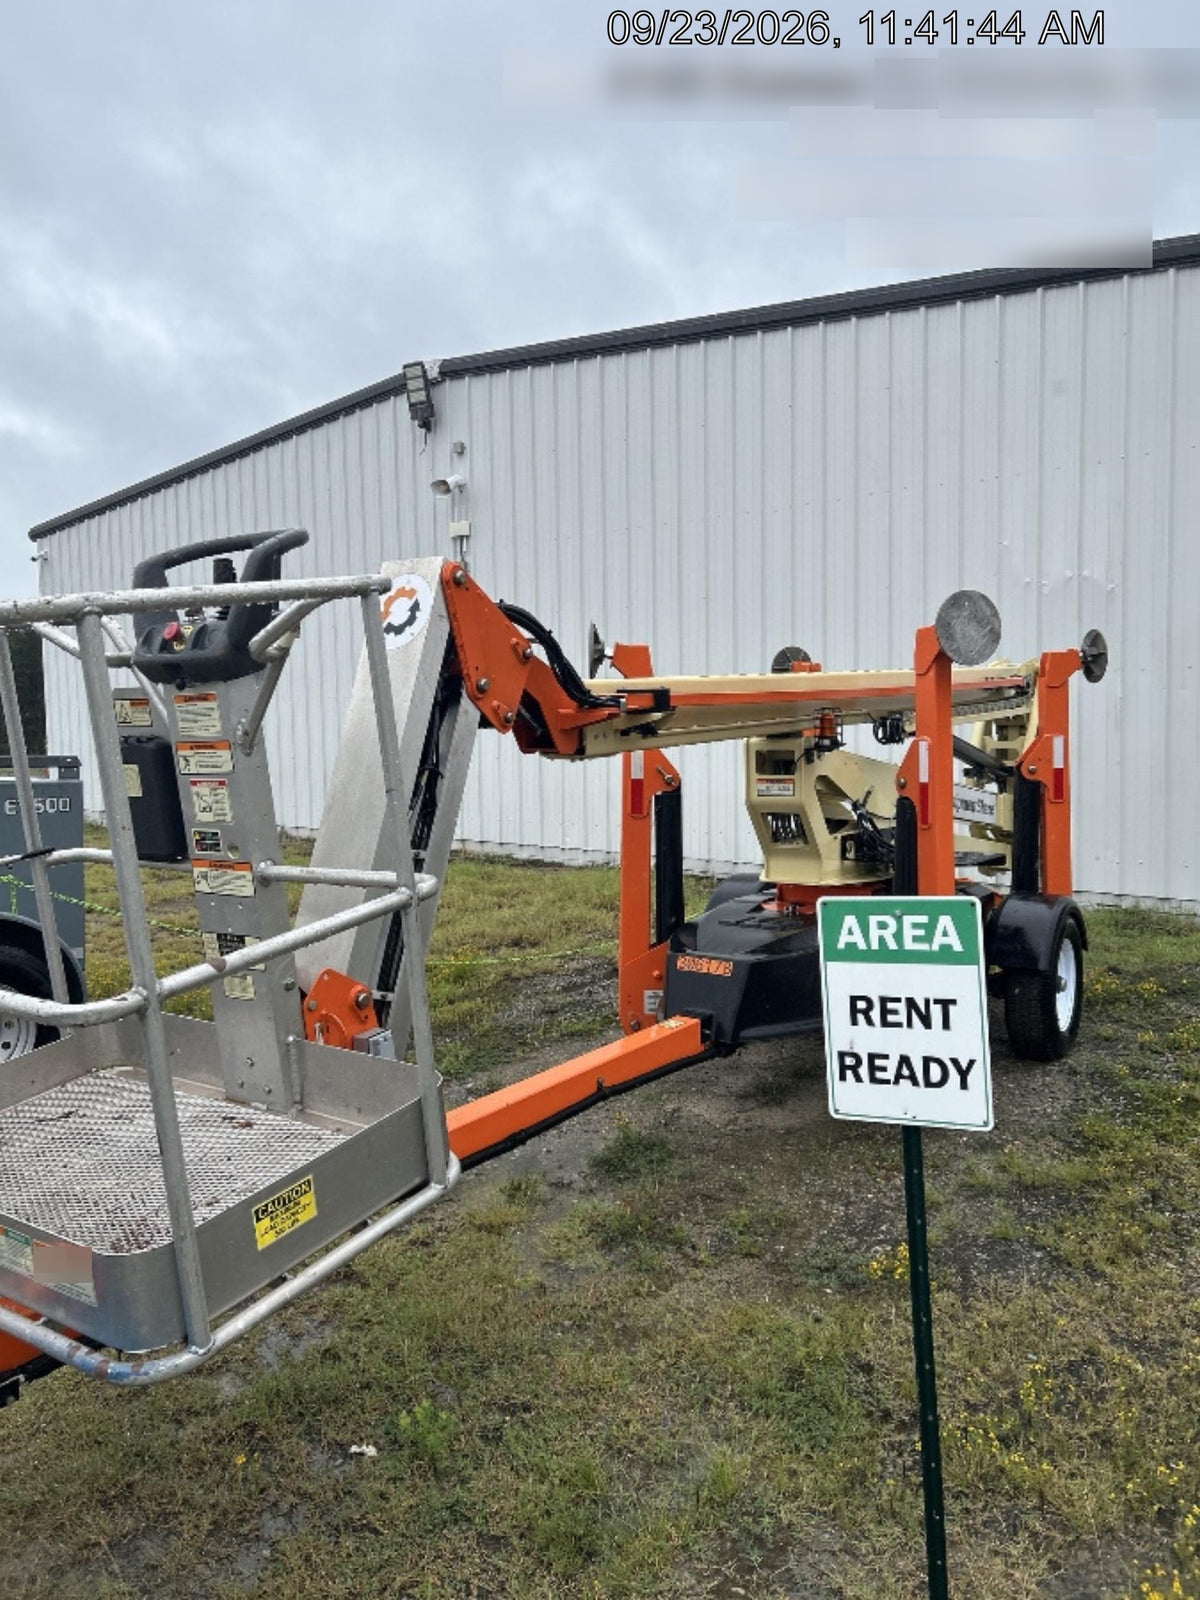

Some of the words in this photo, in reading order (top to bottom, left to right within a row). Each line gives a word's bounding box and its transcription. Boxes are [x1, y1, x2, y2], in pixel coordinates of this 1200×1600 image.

[837, 914, 964, 951] AREA
[849, 995, 957, 1031] RENT
[837, 1050, 977, 1091] READY
[258, 1179, 311, 1219] CAUTION
